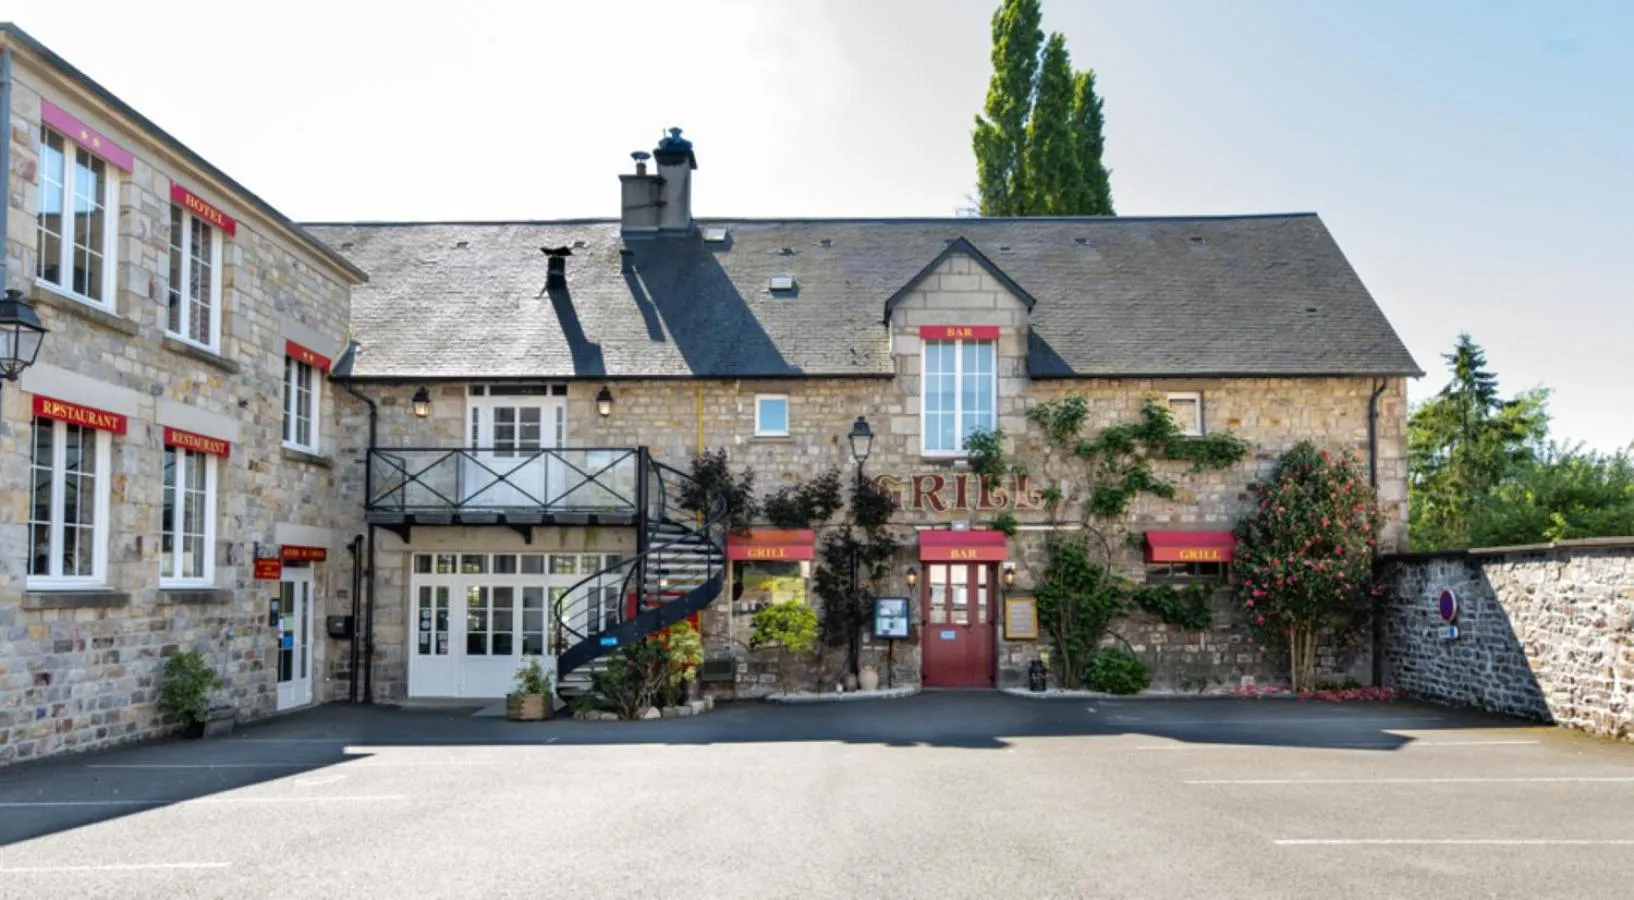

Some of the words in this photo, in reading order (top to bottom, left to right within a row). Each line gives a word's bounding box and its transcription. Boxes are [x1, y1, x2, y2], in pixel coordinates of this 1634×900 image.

[185, 193, 226, 227] HOTEL
[947, 327, 973, 338] BAR
[43, 400, 119, 429] RESTAURANT
[172, 432, 226, 454] RESTAURANT
[747, 548, 788, 559] GRILL
[950, 549, 977, 559] BAR
[1179, 549, 1221, 561] GRILL
